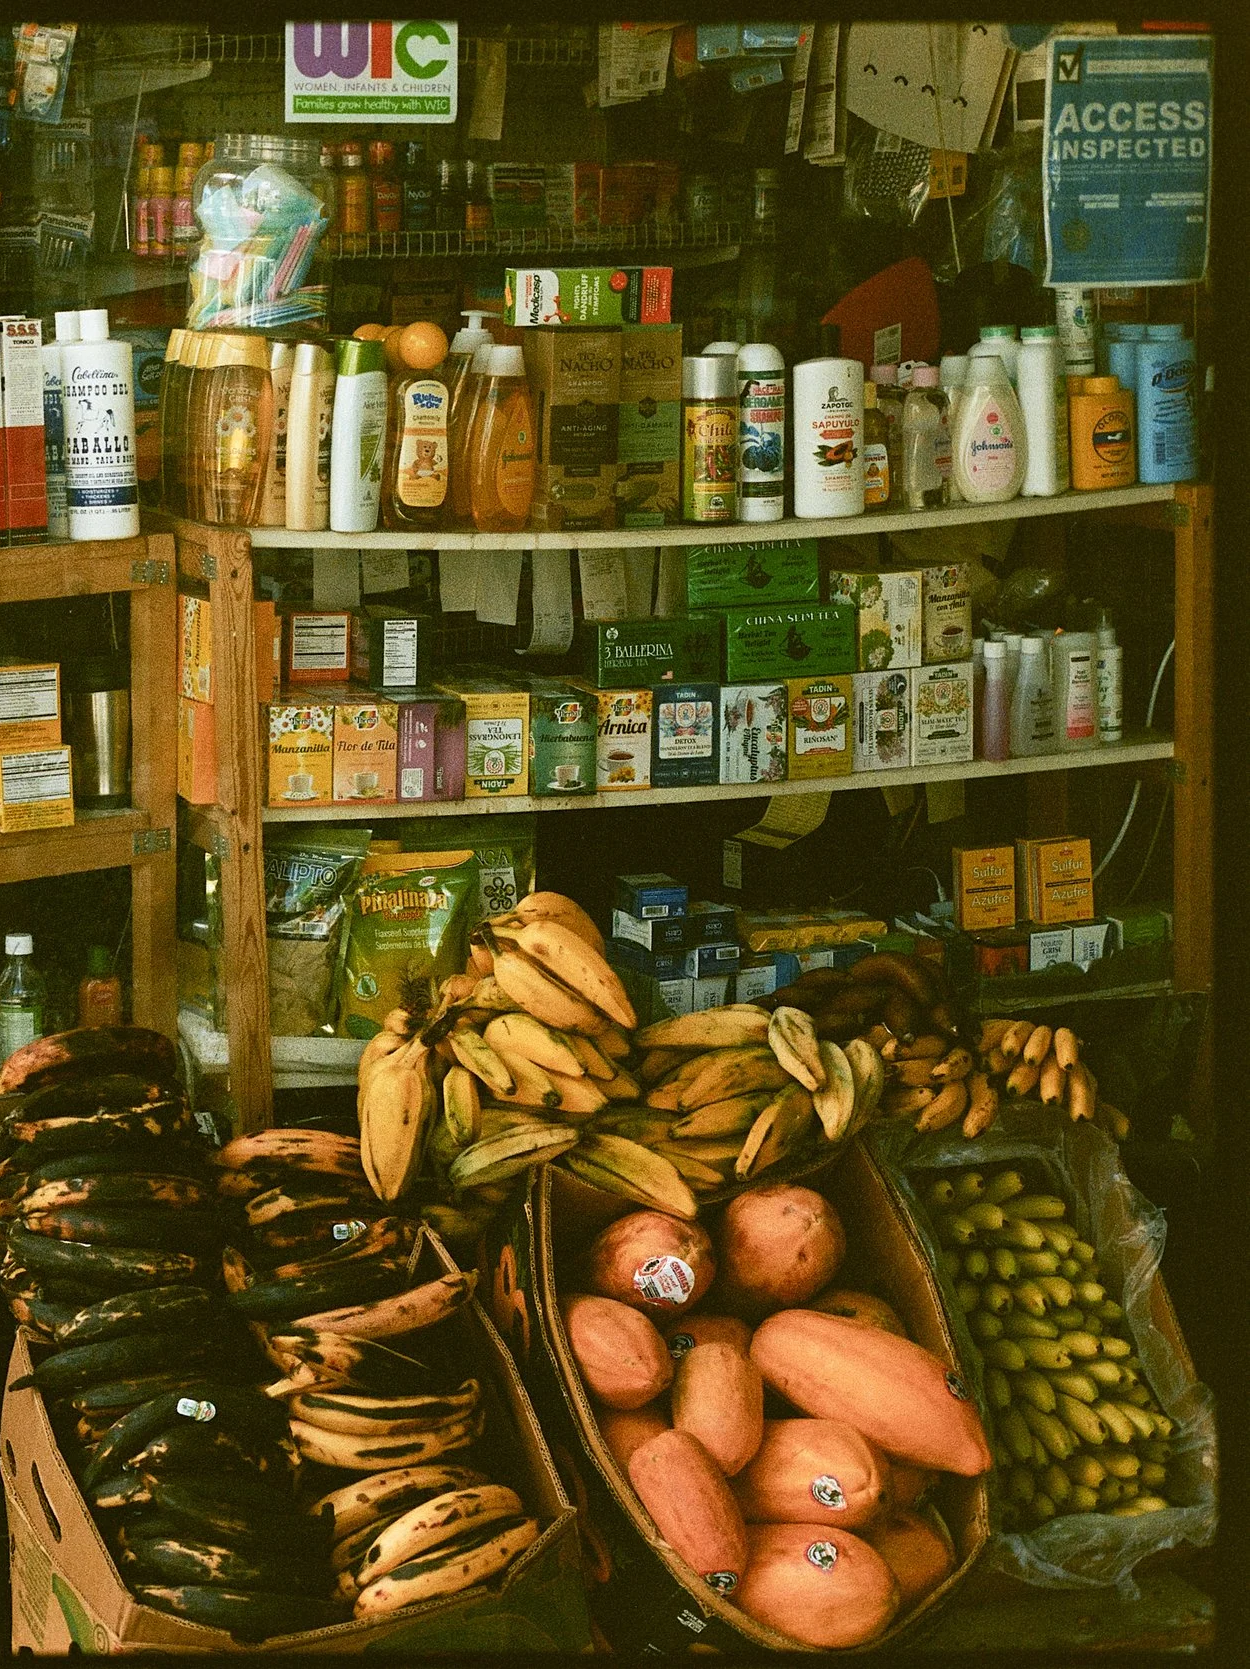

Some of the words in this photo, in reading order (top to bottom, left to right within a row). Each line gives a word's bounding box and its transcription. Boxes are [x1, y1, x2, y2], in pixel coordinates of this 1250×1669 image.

[294, 83, 339, 92] WOMEN,
[344, 83, 387, 92] INFANTS
[391, 83, 398, 92] &
[402, 83, 451, 92] CHILDREN
[295, 98, 334, 110] Families
[338, 101, 361, 111] grow
[364, 98, 398, 112] healthy
[402, 98, 422, 110] with
[424, 99, 448, 110] WIC
[1054, 100, 1206, 133] ACCESS
[1052, 137, 1206, 160] INSPECTED
[42, 213, 88, 231] Panasonic
[530, 274, 543, 324] Medicasp
[580, 274, 589, 321] DANDRUFF
[593, 276, 601, 316] SYMPTOMS
[559, 358, 614, 373] NACHO
[622, 355, 675, 371] NACHO
[746, 615, 783, 626] CHINA
[786, 612, 814, 623] SLIM
[819, 610, 840, 621] TEA
[604, 646, 611, 659] 3
[614, 643, 674, 659] BALLERINA
[634, 658, 649, 668] TEA
[808, 684, 833, 693] TADIN
[487, 726, 503, 734] TEA
[598, 715, 648, 737] Árnica
[468, 733, 521, 741] LEMONGRASS
[271, 744, 331, 754] Manzanilla
[336, 740, 357, 752] Flor
[360, 740, 374, 751] de
[376, 739, 396, 751] Tila
[481, 780, 507, 788] TADIN
[264, 857, 338, 888] ALIPTO
[972, 865, 1007, 878] Sulfur
[1051, 859, 1085, 872] Sulfur
[971, 893, 1010, 908] Azufre
[1051, 886, 1089, 901] Azufre
